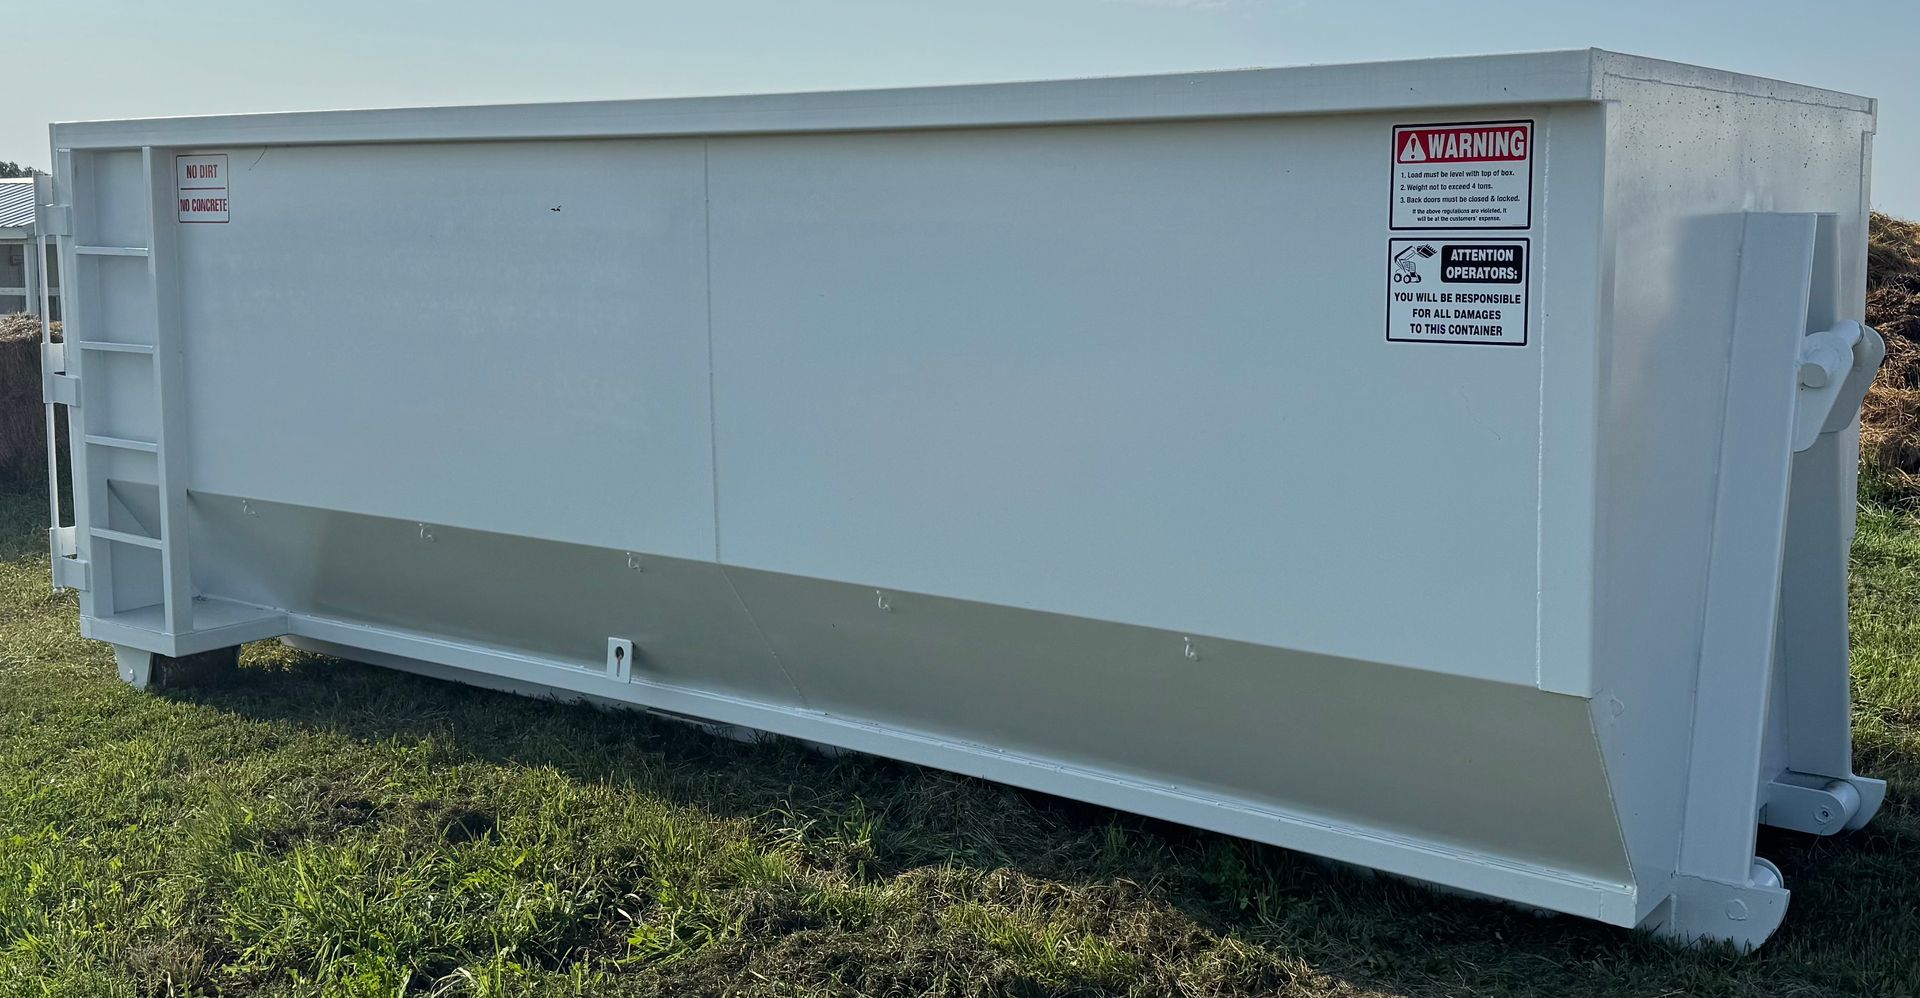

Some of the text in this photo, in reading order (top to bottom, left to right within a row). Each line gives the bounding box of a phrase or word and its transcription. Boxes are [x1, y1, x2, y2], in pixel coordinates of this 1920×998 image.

[1428, 130, 1524, 158] WARNING
[186, 164, 218, 179] NO DIRT
[1481, 170, 1492, 178] top
[180, 198, 228, 212] NO CONCRETE
[1450, 249, 1514, 262] ATTENTION
[1446, 266, 1518, 280] OPERATORS:
[1394, 292, 1521, 304] YOU WILL BE RESPONSIBLE
[1412, 309, 1502, 320] FOR ALL DAMAGES
[1410, 324, 1502, 336] TO THIS CONTAINER
